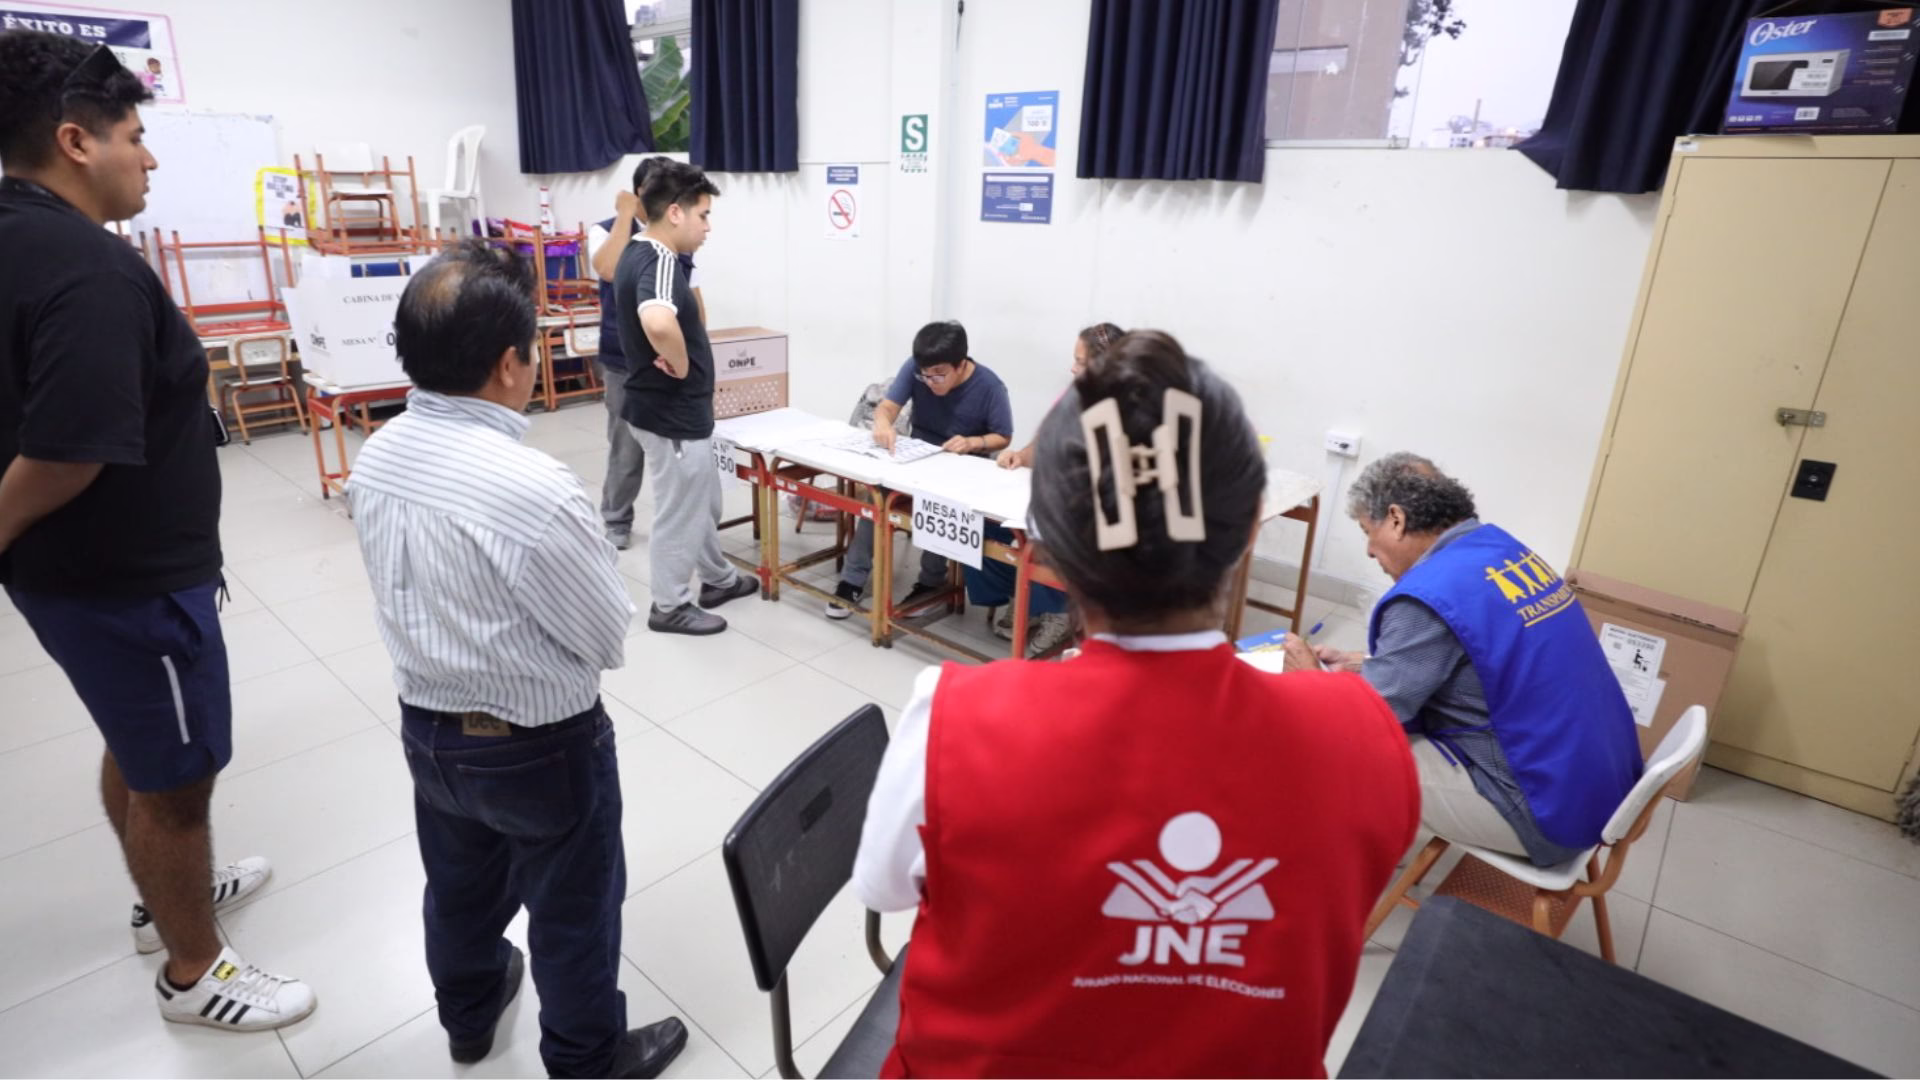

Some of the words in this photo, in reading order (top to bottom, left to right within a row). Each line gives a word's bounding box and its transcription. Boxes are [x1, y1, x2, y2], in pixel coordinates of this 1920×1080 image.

[2, 14, 74, 36] ÉXITO
[78, 23, 108, 38] ES
[1750, 19, 1817, 47] Oster
[905, 117, 924, 151] S
[342, 293, 381, 304] CABINA
[381, 293, 393, 303] DE
[728, 357, 756, 369] ONPE
[713, 453, 735, 474] 350
[922, 498, 958, 521] MESA
[961, 511, 976, 525] Nº
[914, 511, 980, 549] 053350
[1117, 923, 1249, 968] JNE
[1072, 975, 1121, 988] JURADO
[1123, 974, 1184, 985] NACIONAL
[1187, 974, 1204, 985] DE
[1206, 974, 1286, 999] ELECCIONES
